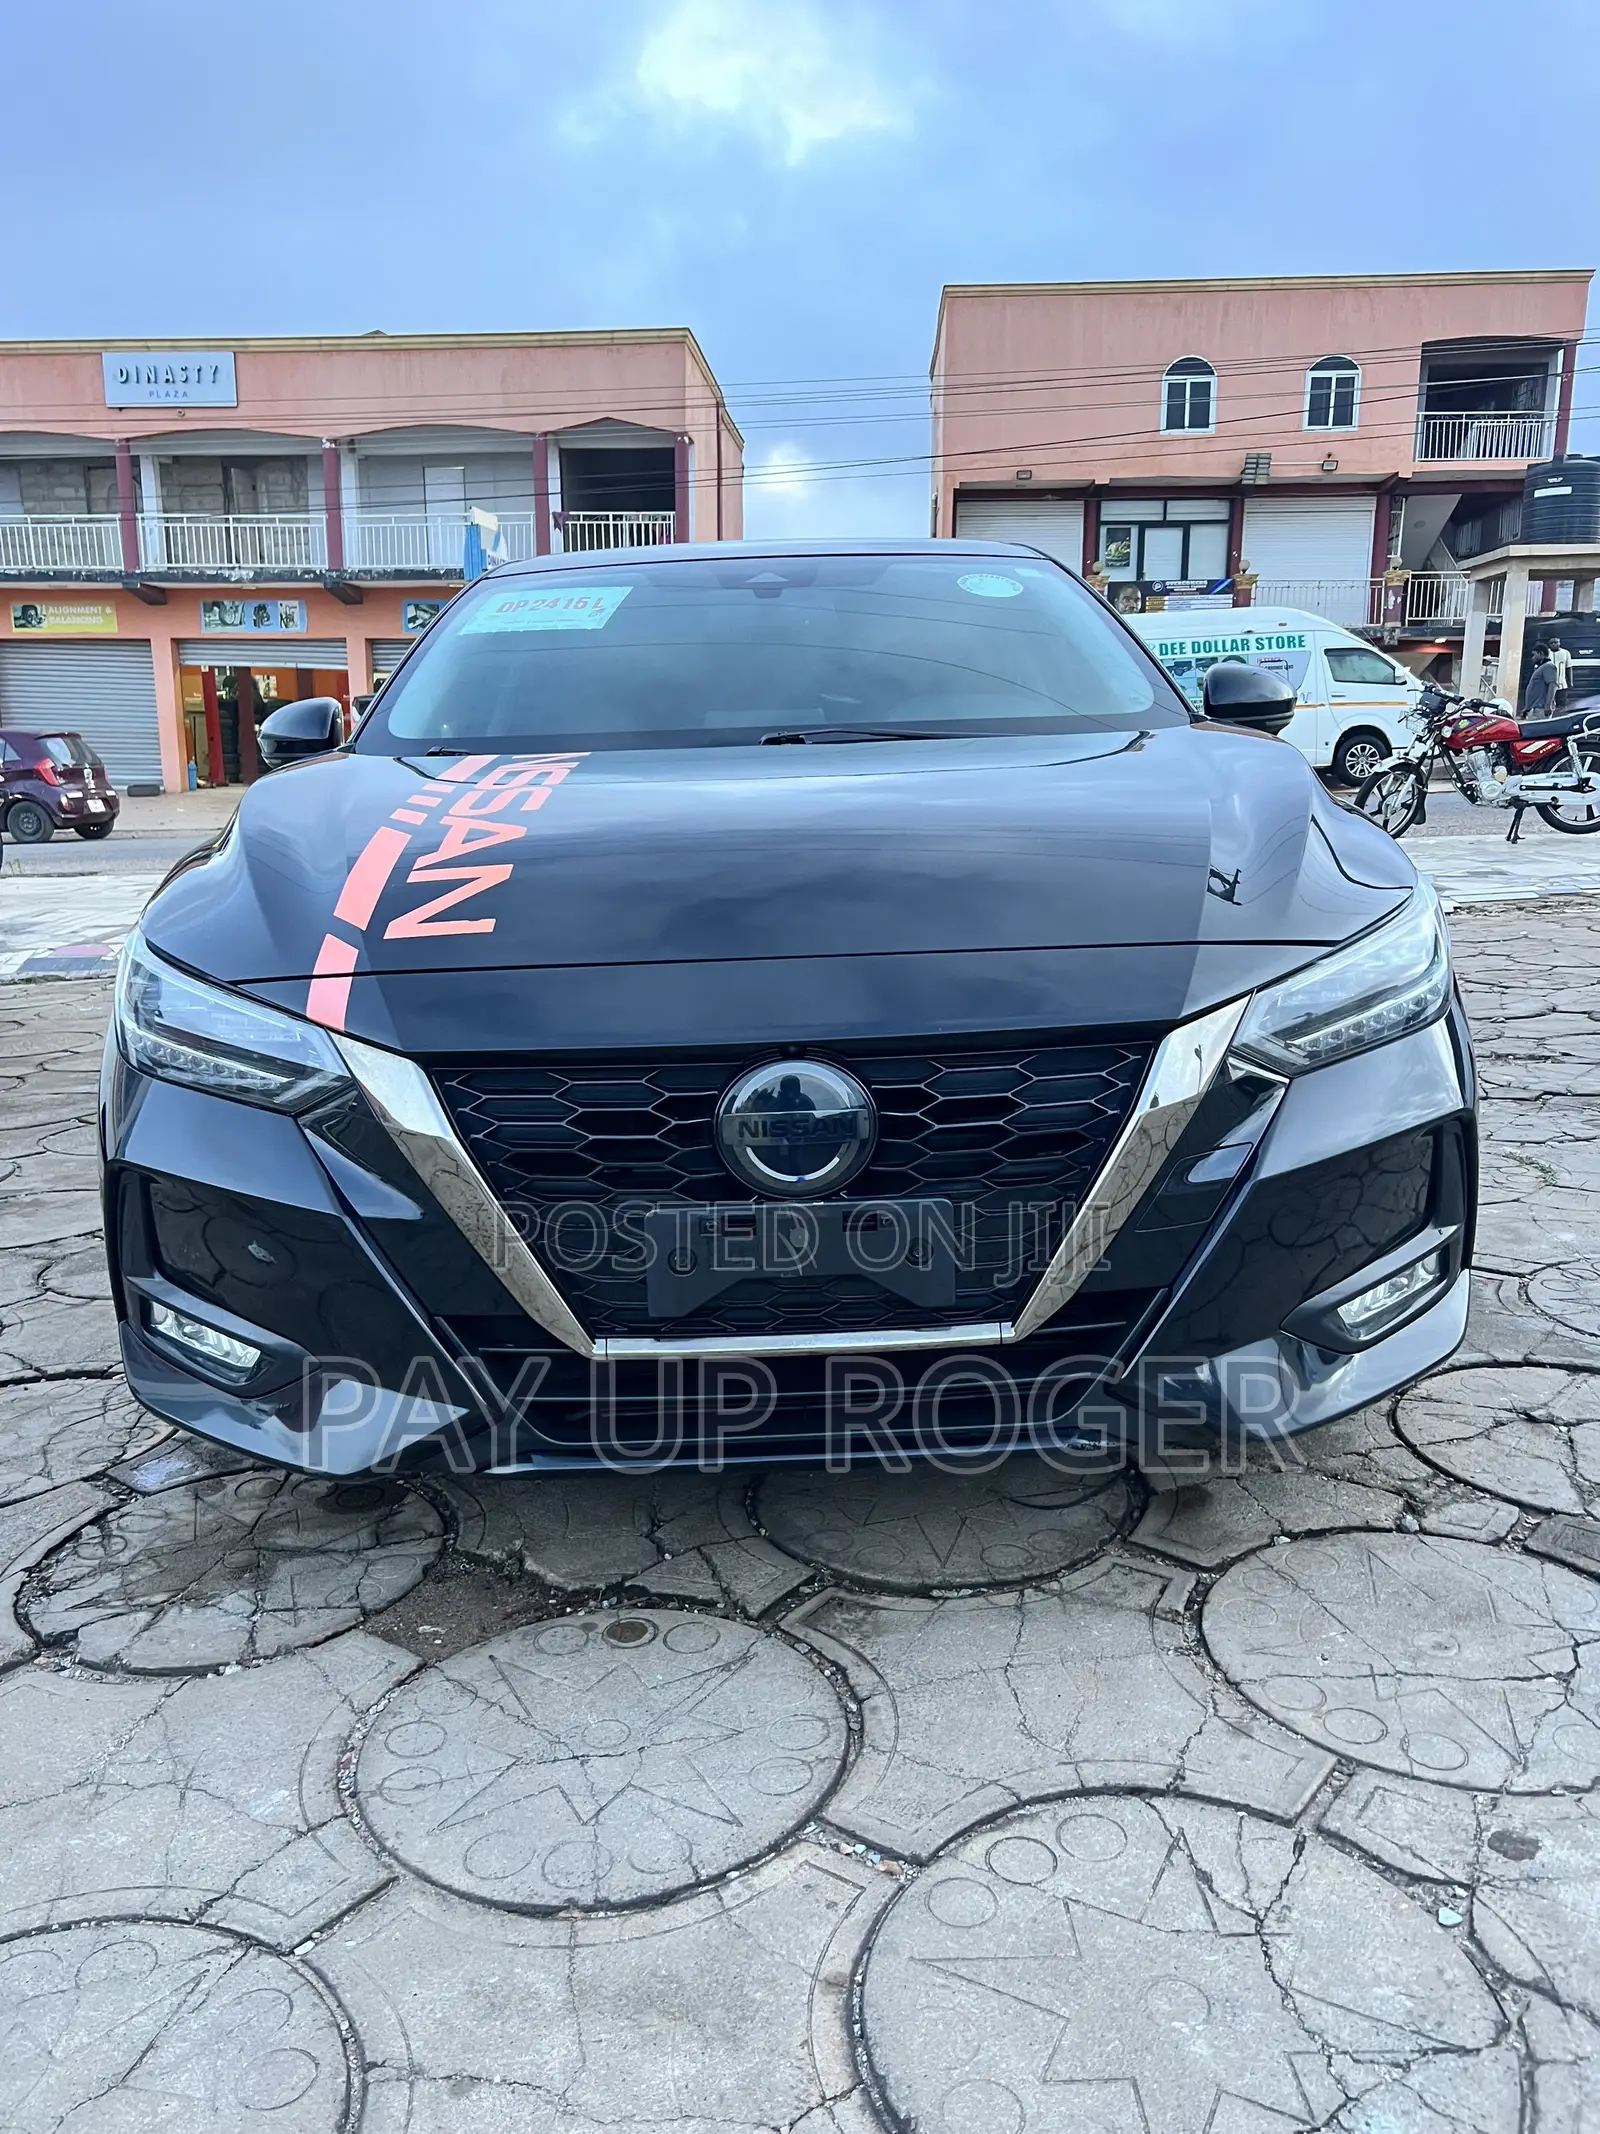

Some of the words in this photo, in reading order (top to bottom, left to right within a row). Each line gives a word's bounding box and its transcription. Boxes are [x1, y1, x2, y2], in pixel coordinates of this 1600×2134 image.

[117, 364, 220, 384] DINASTY
[149, 390, 188, 399] PLAZA
[48, 605, 102, 614] ALIGNMENT
[1159, 643, 1187, 656] DEE
[1191, 638, 1250, 655] DOLLAR
[1255, 634, 1306, 651] STORE
[738, 1113, 858, 1140] NISSAN
